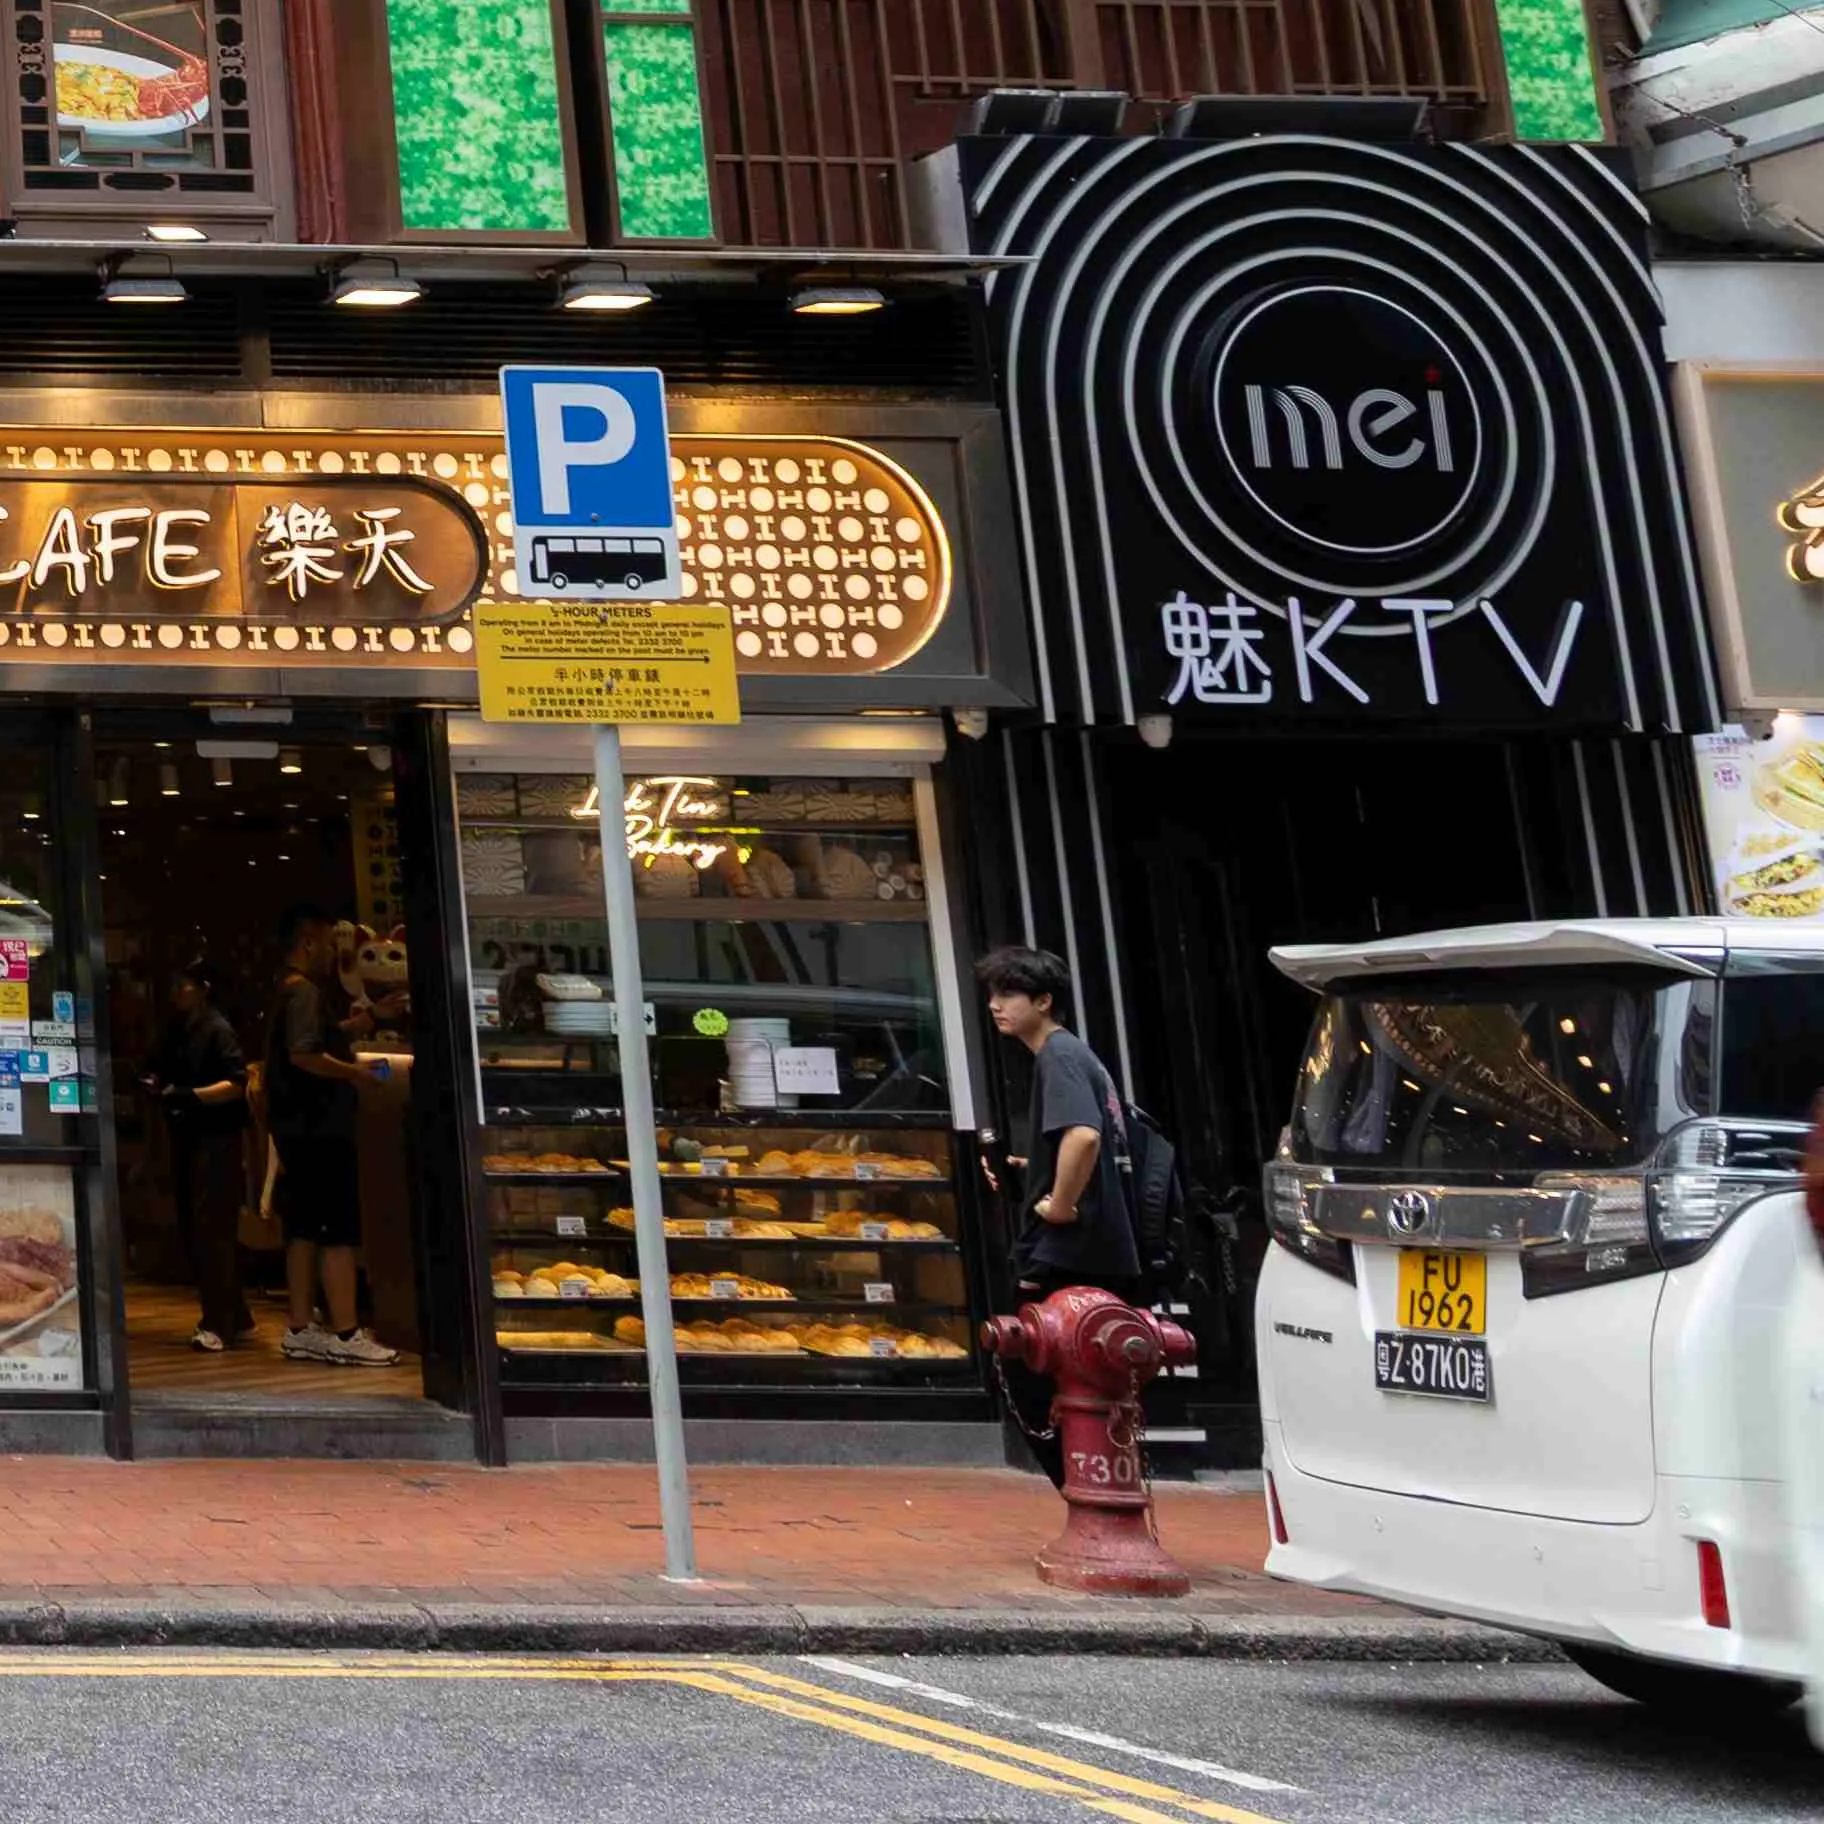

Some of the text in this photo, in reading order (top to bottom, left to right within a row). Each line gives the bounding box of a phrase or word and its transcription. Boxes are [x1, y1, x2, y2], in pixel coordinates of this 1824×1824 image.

[533, 383, 636, 515] P
[1244, 368, 1455, 473] mei
[256, 503, 436, 600] 樂天
[1161, 591, 1583, 707] 魅KTV
[571, 776, 719, 827] Lk Tin
[1409, 1289, 1473, 1331] 1962
[1423, 1255, 1462, 1292] FU
